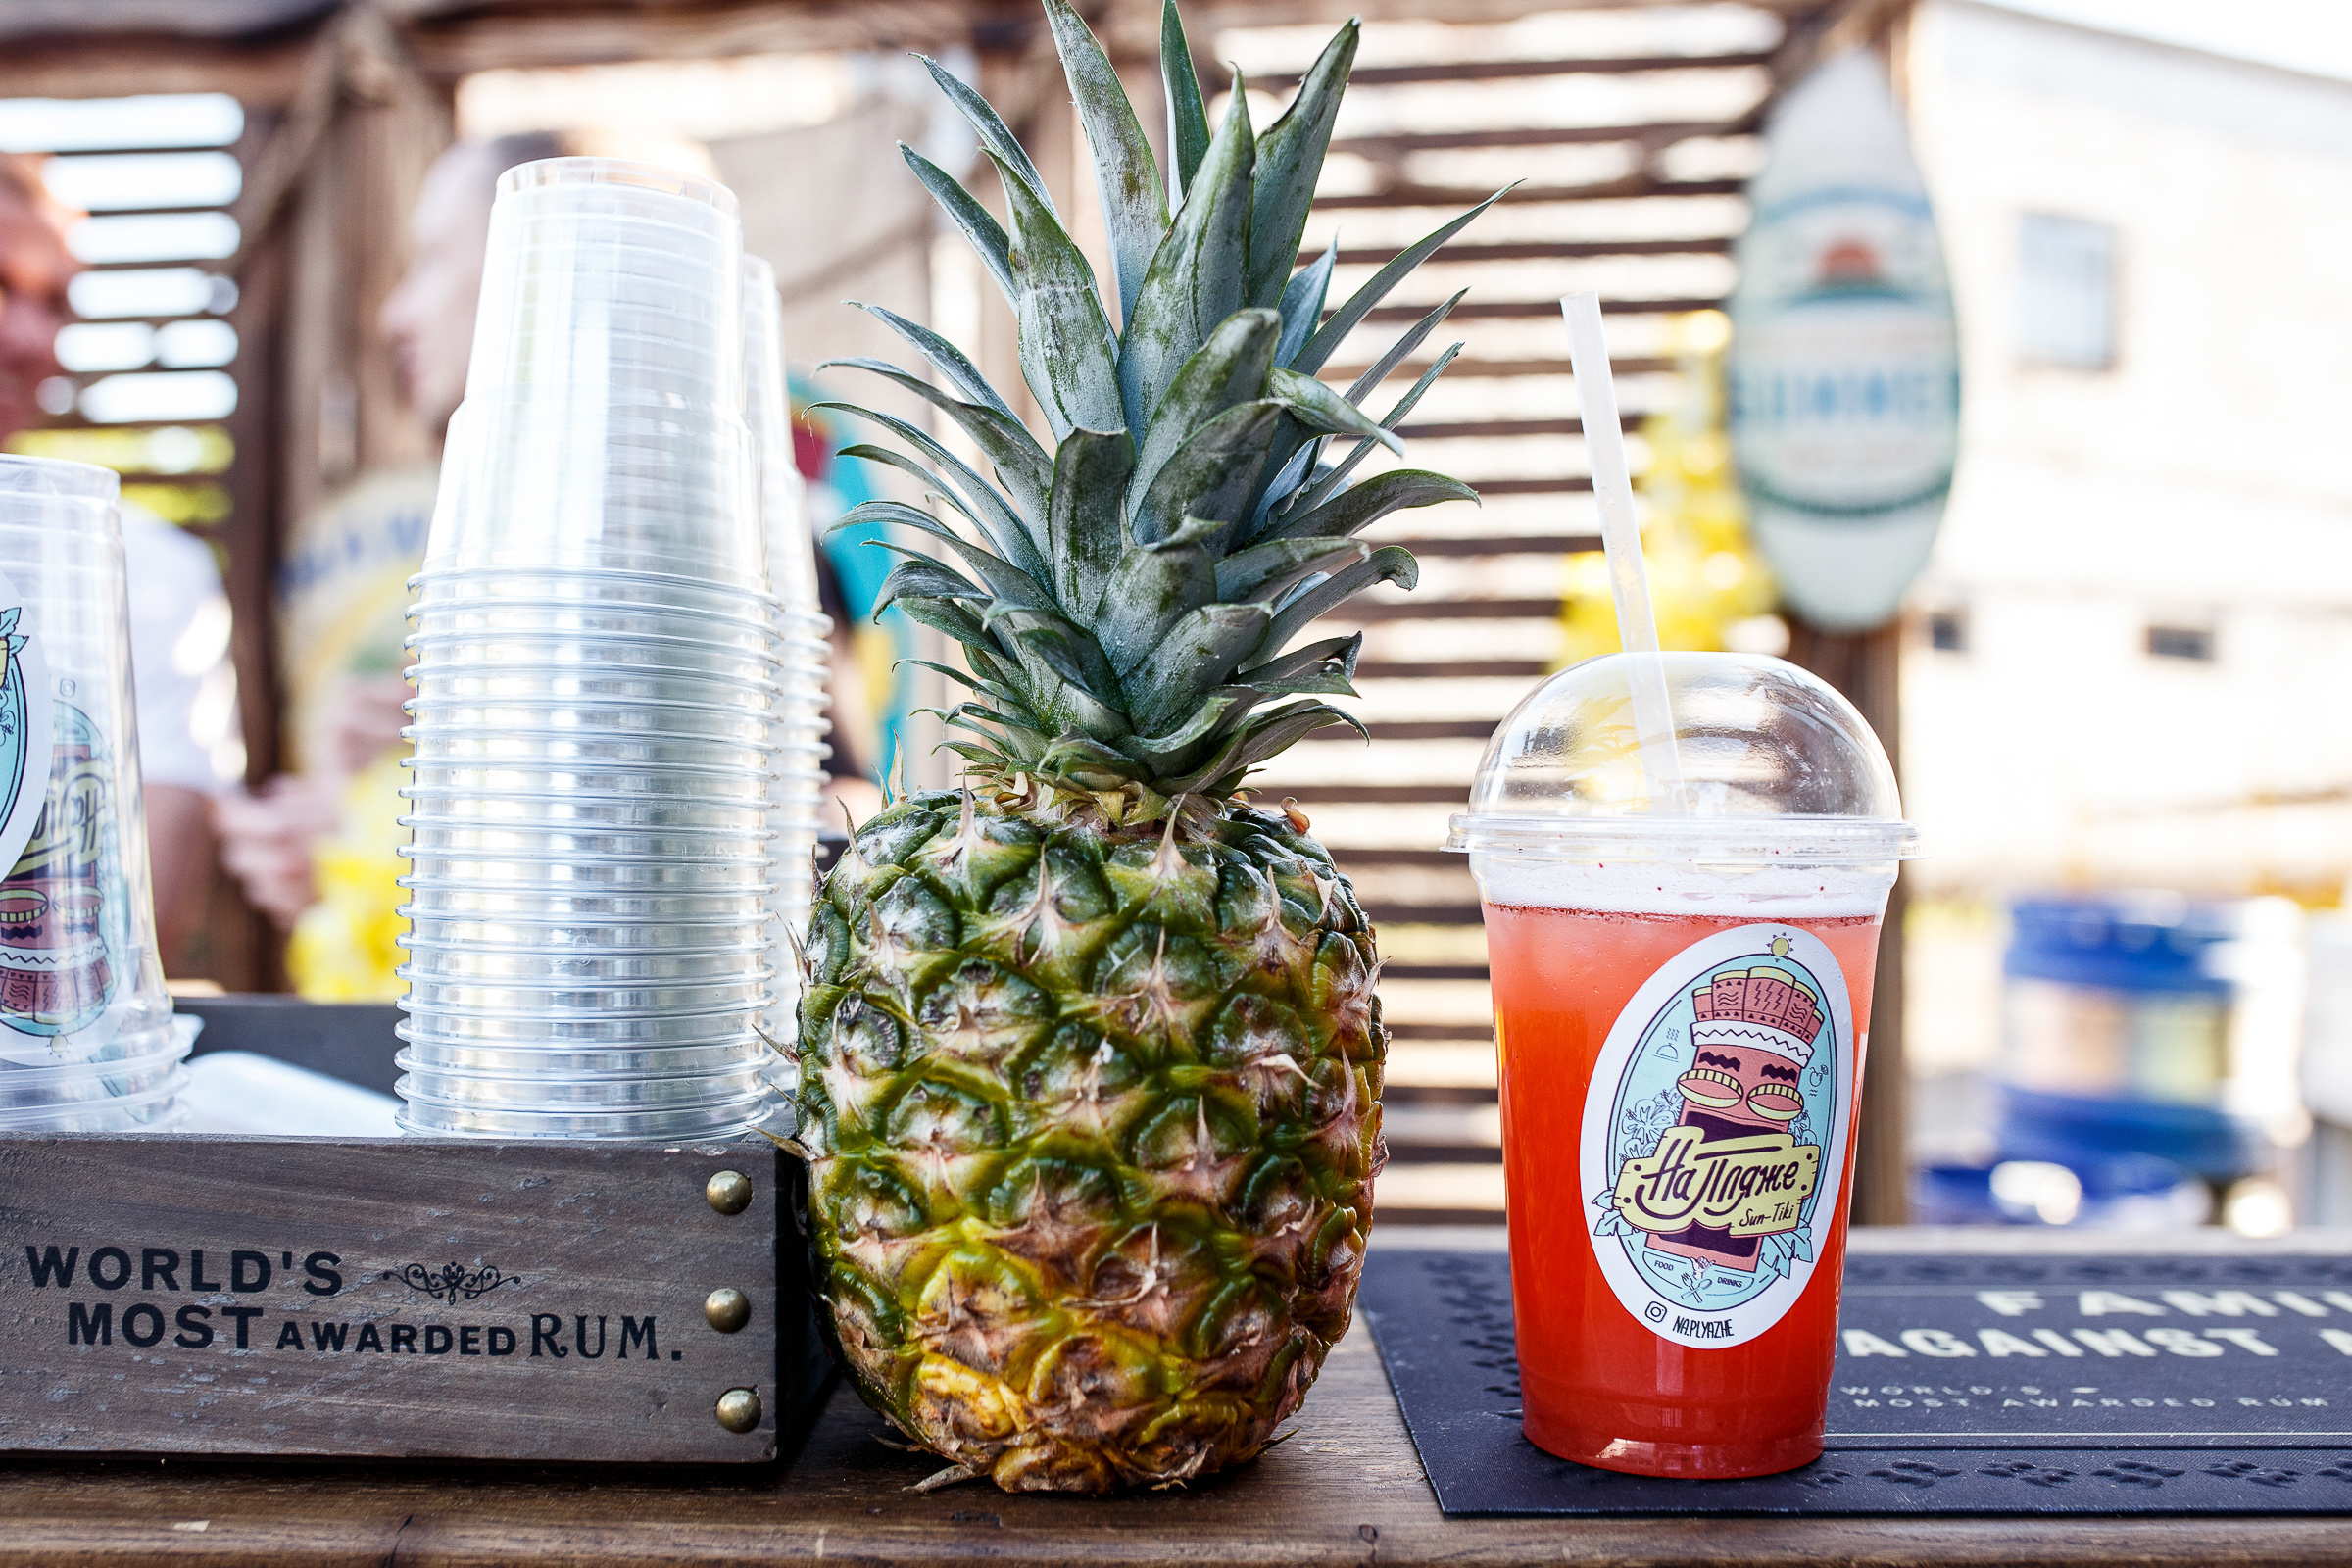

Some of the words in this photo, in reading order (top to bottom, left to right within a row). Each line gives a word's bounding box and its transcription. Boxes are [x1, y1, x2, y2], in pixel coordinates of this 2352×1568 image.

[1642, 1138, 1698, 1201] На
[1739, 1201, 1795, 1227] Sun-Tiki
[25, 1245, 343, 1297] WORLD'S
[1653, 1259, 1675, 1272] FOOD
[1716, 1276, 1743, 1288] DRINKS
[68, 1302, 264, 1349] MOST
[275, 1321, 517, 1357] AWARDED
[529, 1313, 683, 1361] RUM.
[1672, 1315, 1735, 1339] NA.PLYAZHE
[1841, 1328, 2280, 1358] AGAINST
[1839, 1385, 2043, 1396] WORLD'S
[1853, 1398, 1971, 1408] MOST
[2003, 1397, 2217, 1408] AWARDED
